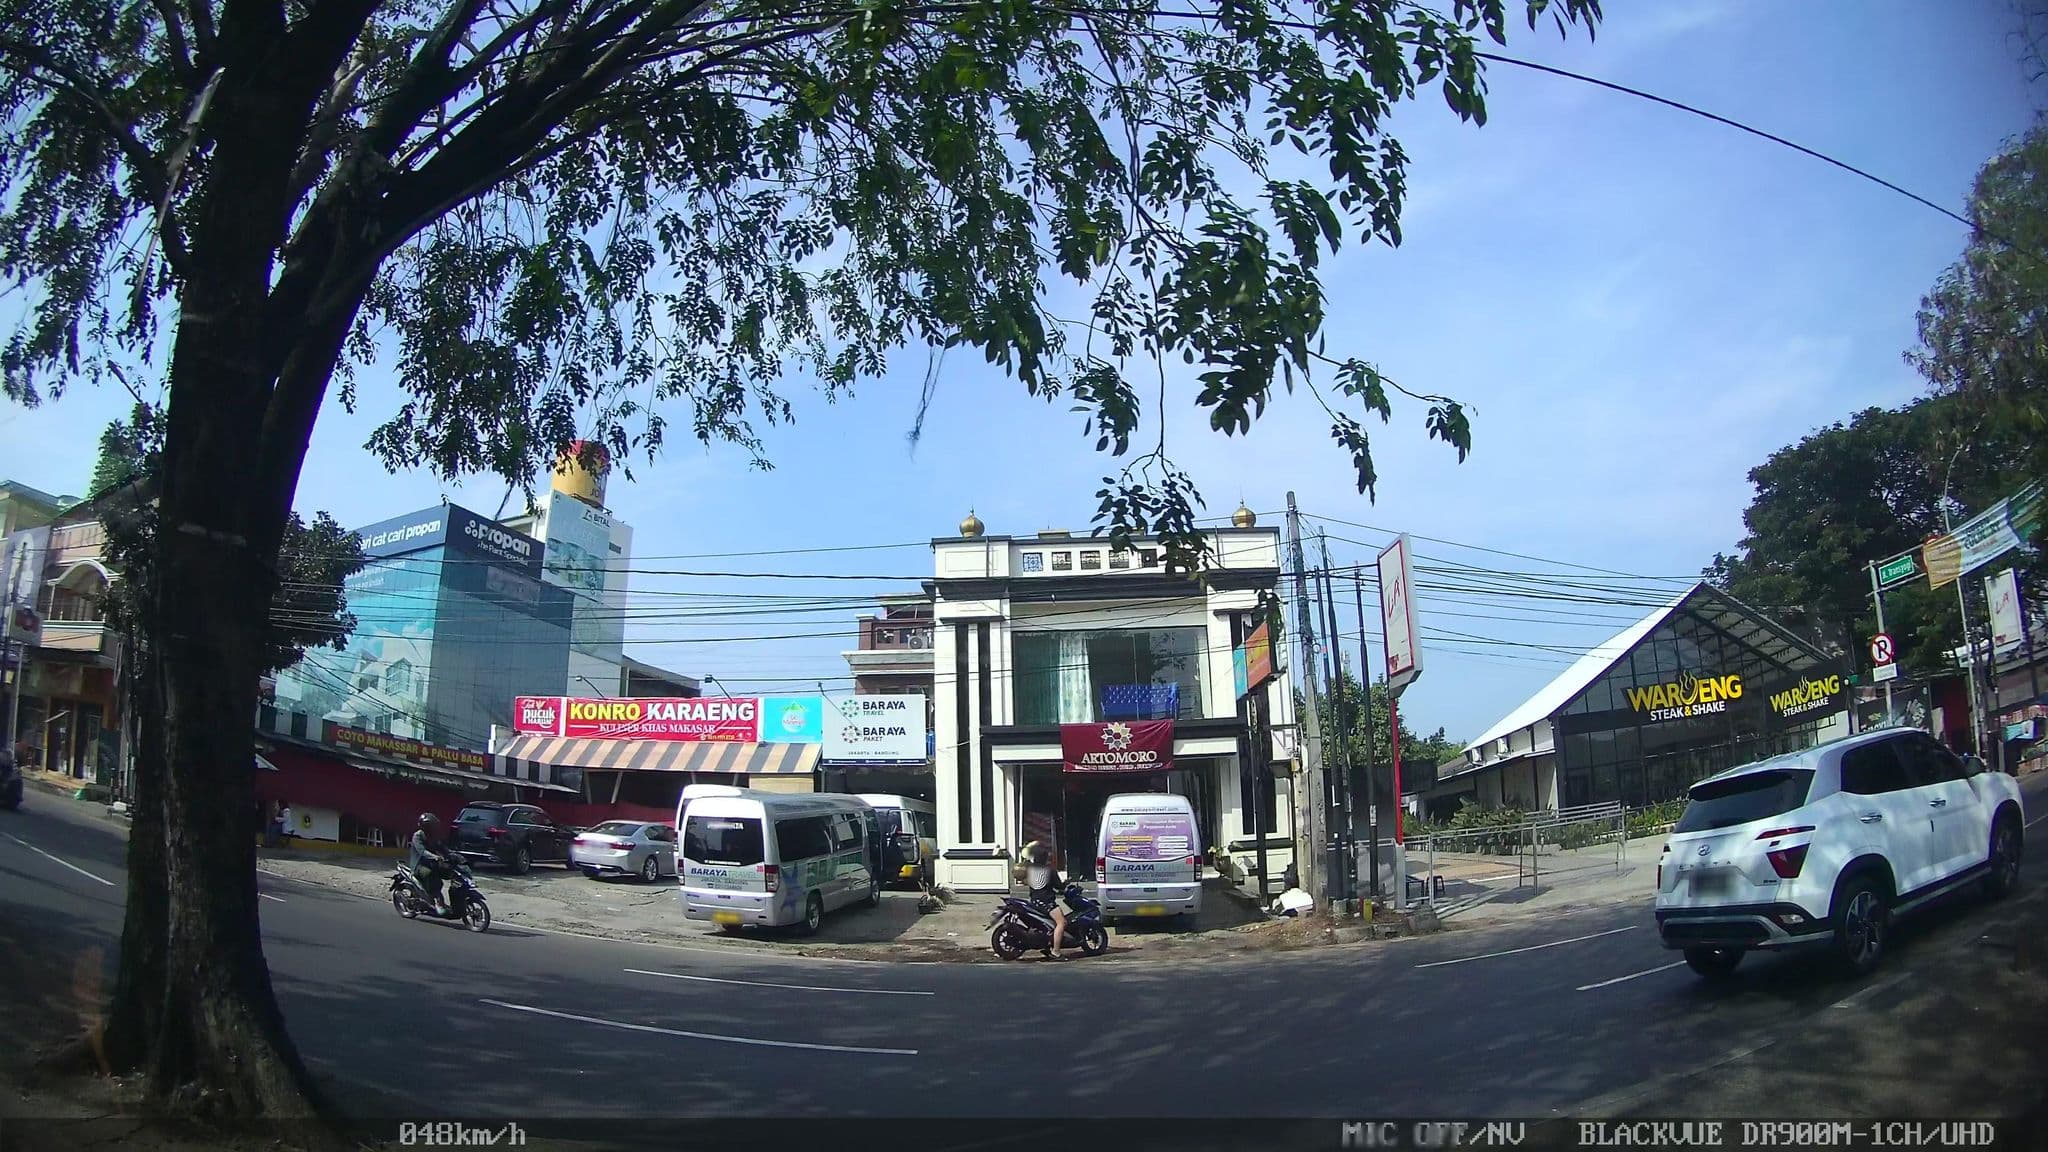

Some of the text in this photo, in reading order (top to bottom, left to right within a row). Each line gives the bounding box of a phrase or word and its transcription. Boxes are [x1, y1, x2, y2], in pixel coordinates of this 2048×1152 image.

[372, 532, 387, 547] cat
[388, 525, 407, 543] cari
[405, 520, 441, 539] propan
[479, 523, 531, 557] propan
[570, 702, 755, 721] KONRO KARAENG
[862, 701, 906, 710] BARAYA
[523, 706, 556, 724] pucuk
[642, 723, 667, 733] KHAS
[669, 723, 716, 734] MAKASAR
[862, 727, 906, 736] BARAYA
[336, 729, 484, 766] COTO MAKASSAR & PALLU BASA
[1081, 750, 1158, 764] ARTOMORO
[690, 867, 728, 877] BARAYA
[1113, 864, 1155, 872] BARAYA
